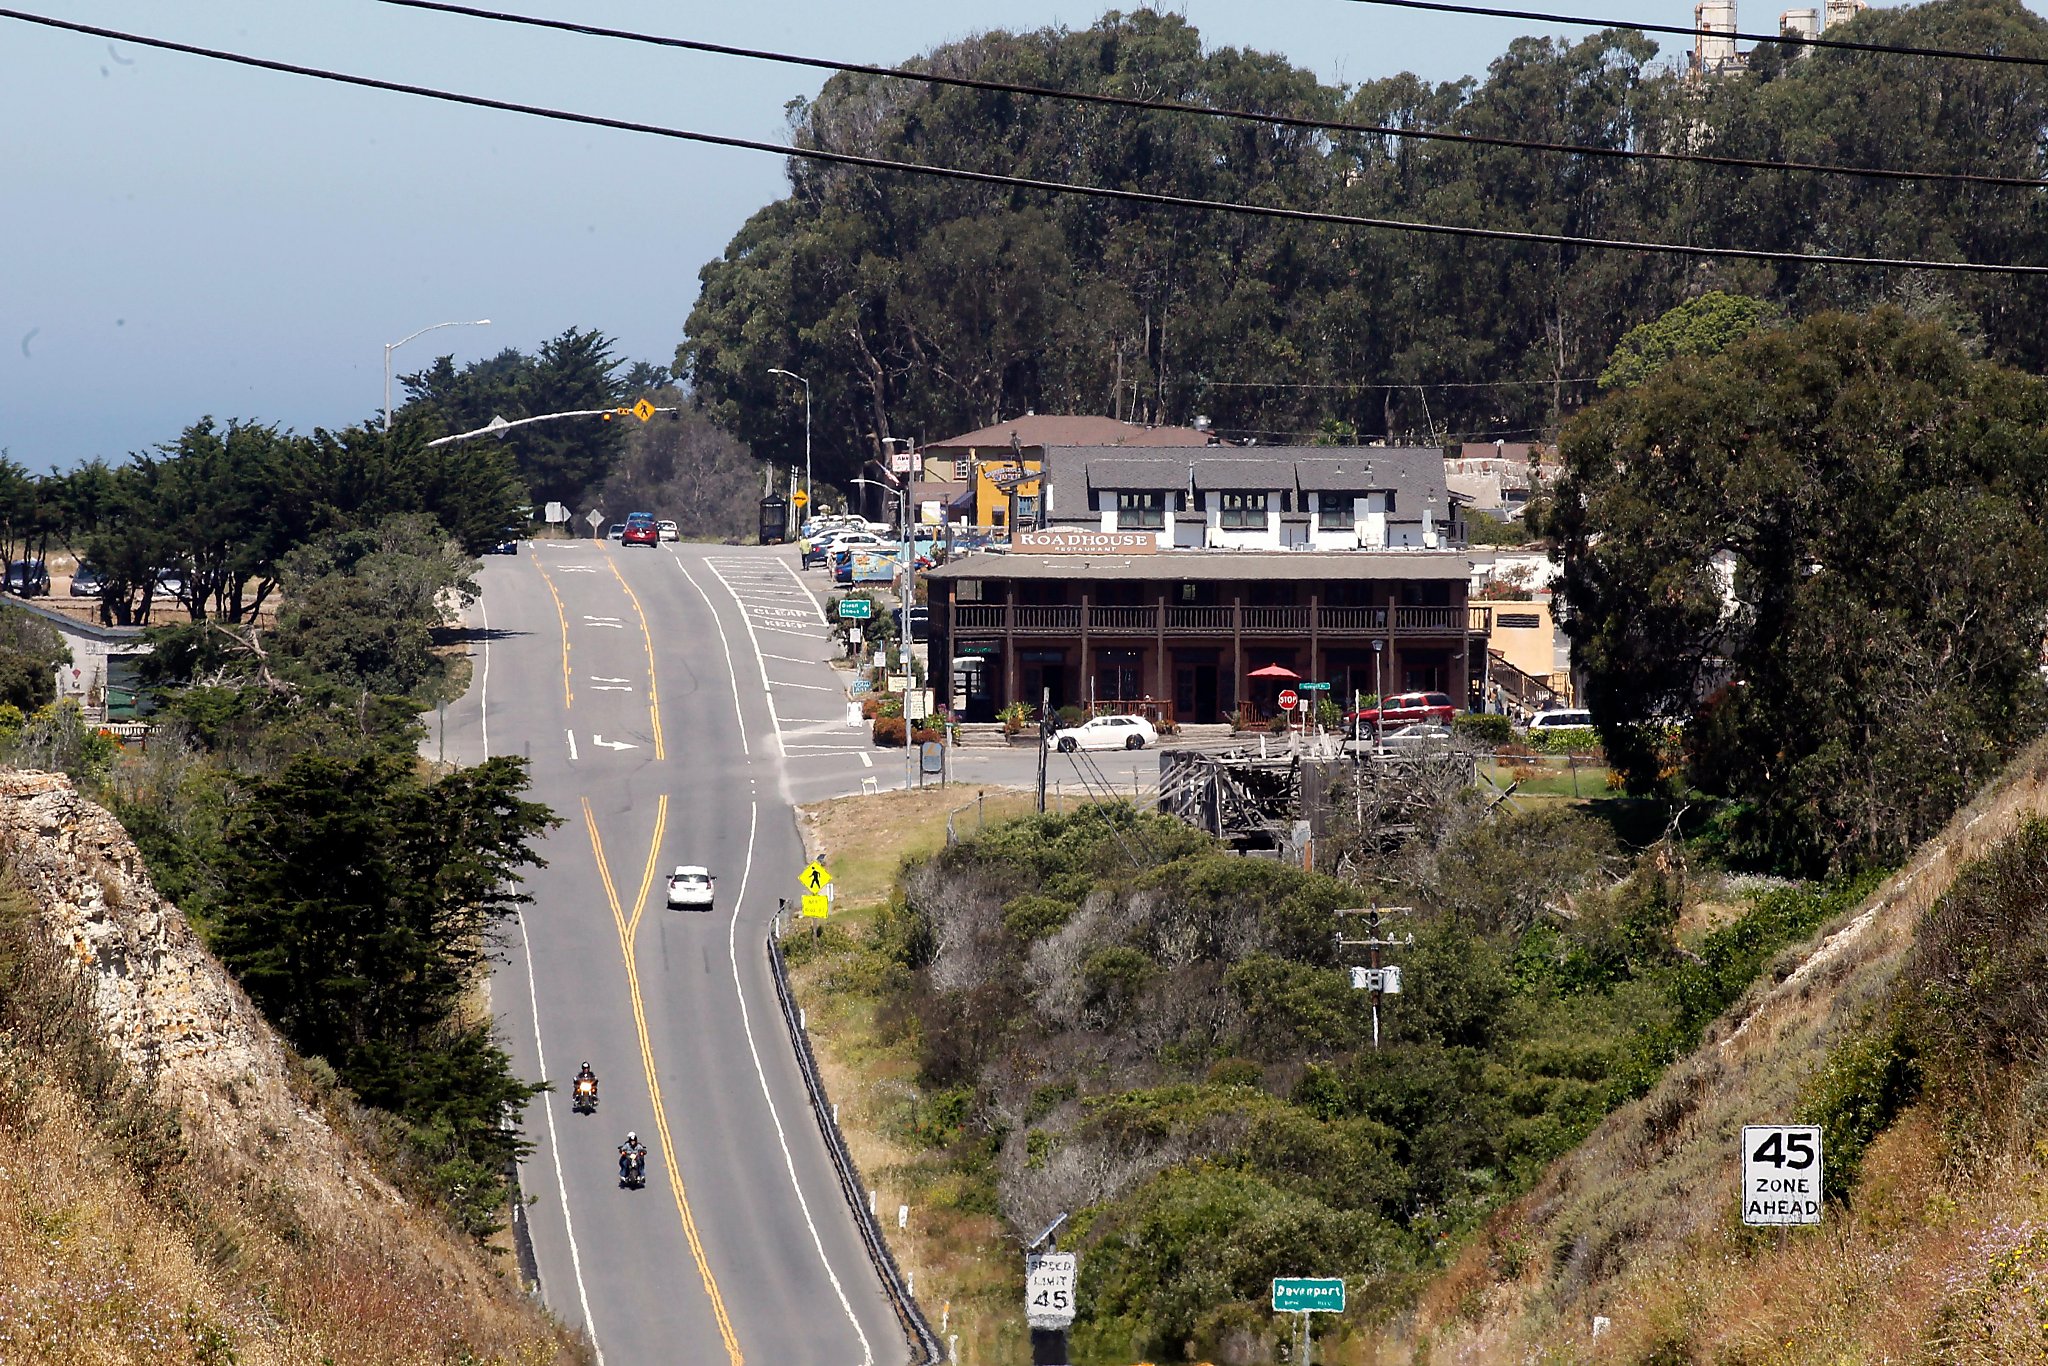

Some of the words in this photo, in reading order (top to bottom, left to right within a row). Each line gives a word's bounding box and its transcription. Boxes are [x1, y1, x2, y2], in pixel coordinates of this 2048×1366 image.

[1020, 534, 1148, 546] ROADHOUSE
[753, 608, 807, 617] CLEAR
[1280, 696, 1297, 704] STOP
[1753, 1132, 1815, 1170] 45
[1756, 1178, 1810, 1193] ZONE
[1748, 1200, 1818, 1215] AHEAD
[1031, 1260, 1071, 1271] SPEED
[1034, 1275, 1067, 1286] LIMIT
[1276, 1284, 1341, 1298] Davenport
[1033, 1290, 1069, 1311] 45
